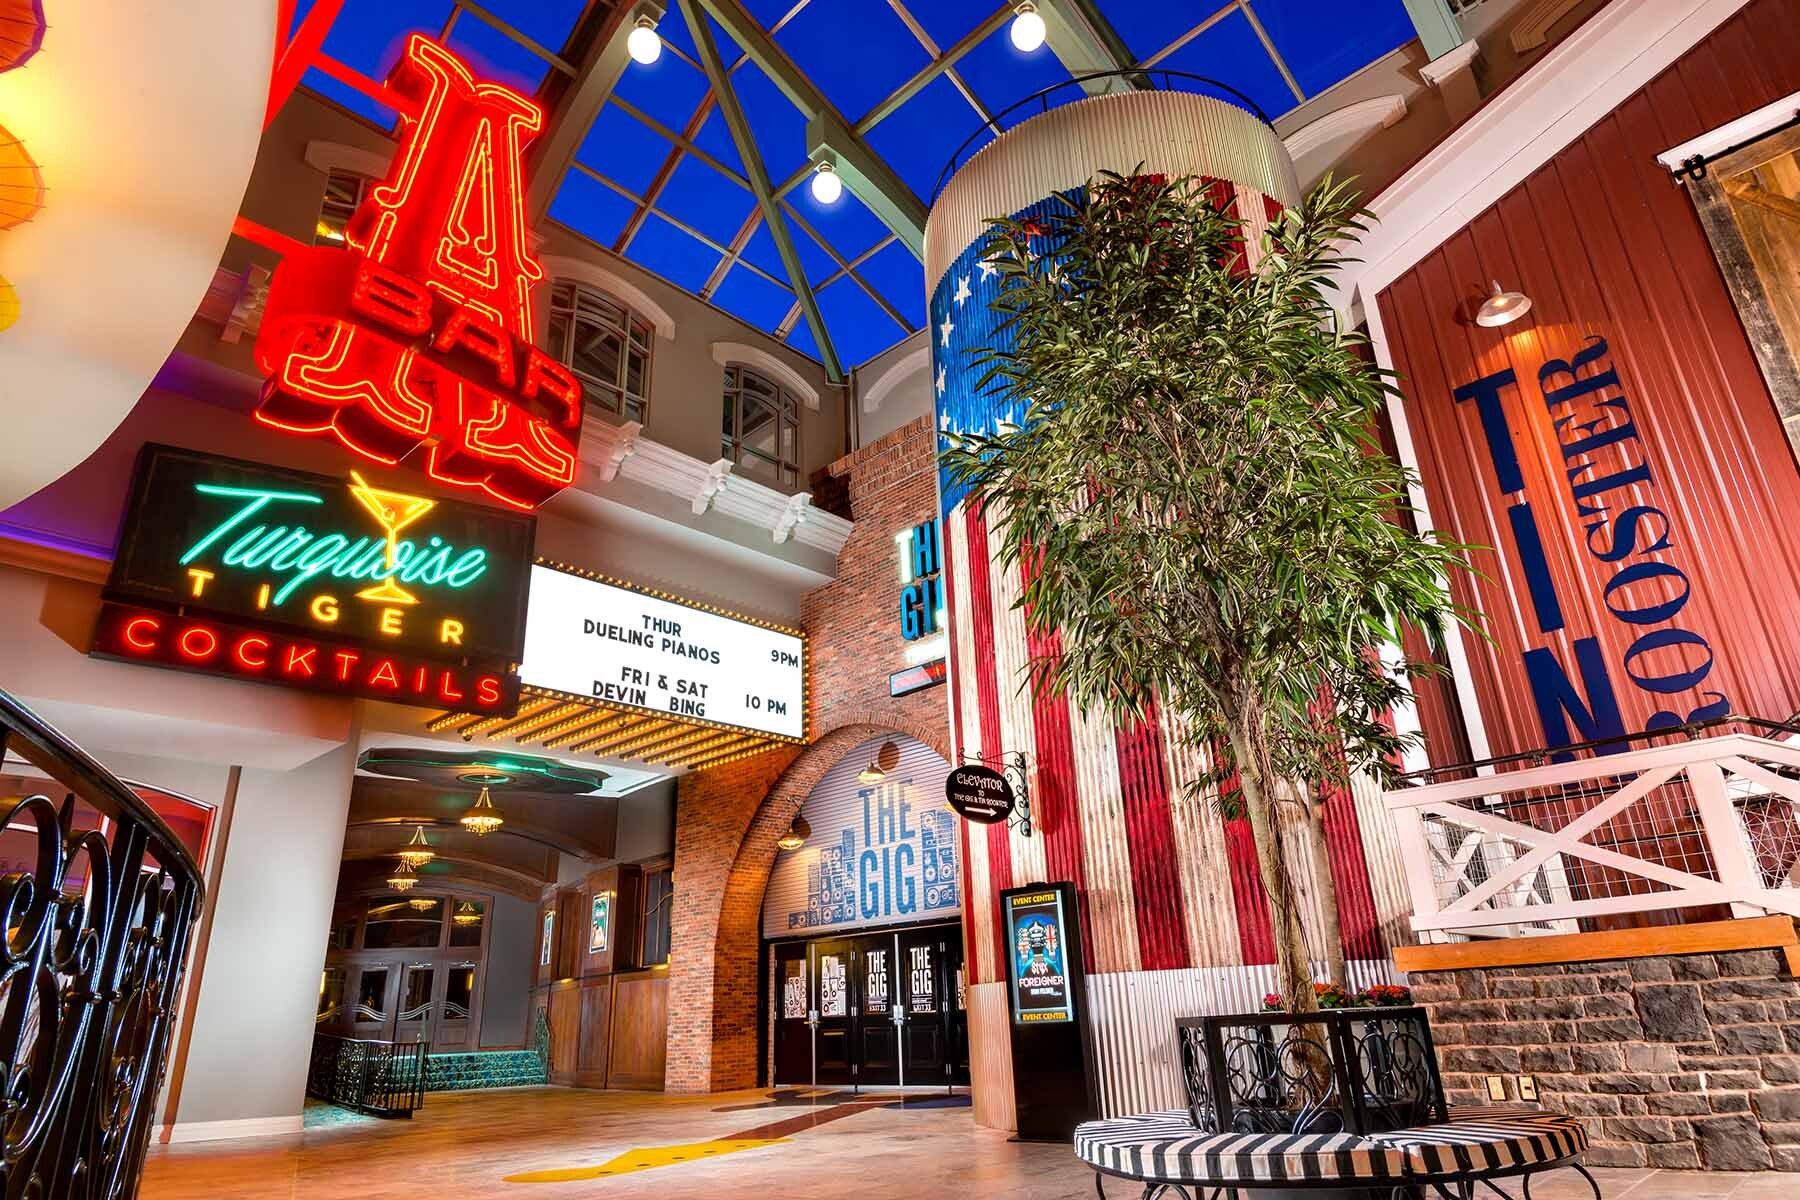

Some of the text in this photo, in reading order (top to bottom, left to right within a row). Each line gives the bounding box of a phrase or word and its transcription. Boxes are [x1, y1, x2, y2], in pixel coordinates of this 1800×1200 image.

[352, 264, 582, 430] BAR
[180, 483, 488, 606] Turquoise
[1454, 368, 1639, 788] TIN
[186, 567, 466, 646] TIGER
[641, 614, 682, 637] THUR
[583, 618, 721, 665] DUELING PIANOS
[123, 617, 501, 704] COCKTAILS
[770, 649, 799, 668] 9PM
[621, 666, 708, 699] FRI & SAT
[592, 680, 706, 717] DEVIN BING
[745, 694, 787, 716] 10 PM
[858, 778, 916, 847] THE
[859, 843, 917, 920] GIG
[1012, 893, 1056, 906] EVENT CENTER
[866, 951, 887, 973] THE
[910, 946, 931, 969] THE
[867, 972, 888, 998] GIG
[911, 969, 933, 995] GIG
[1018, 975, 1064, 988] FOREIGNER
[1022, 1012, 1067, 1022] EVENT CENTER
